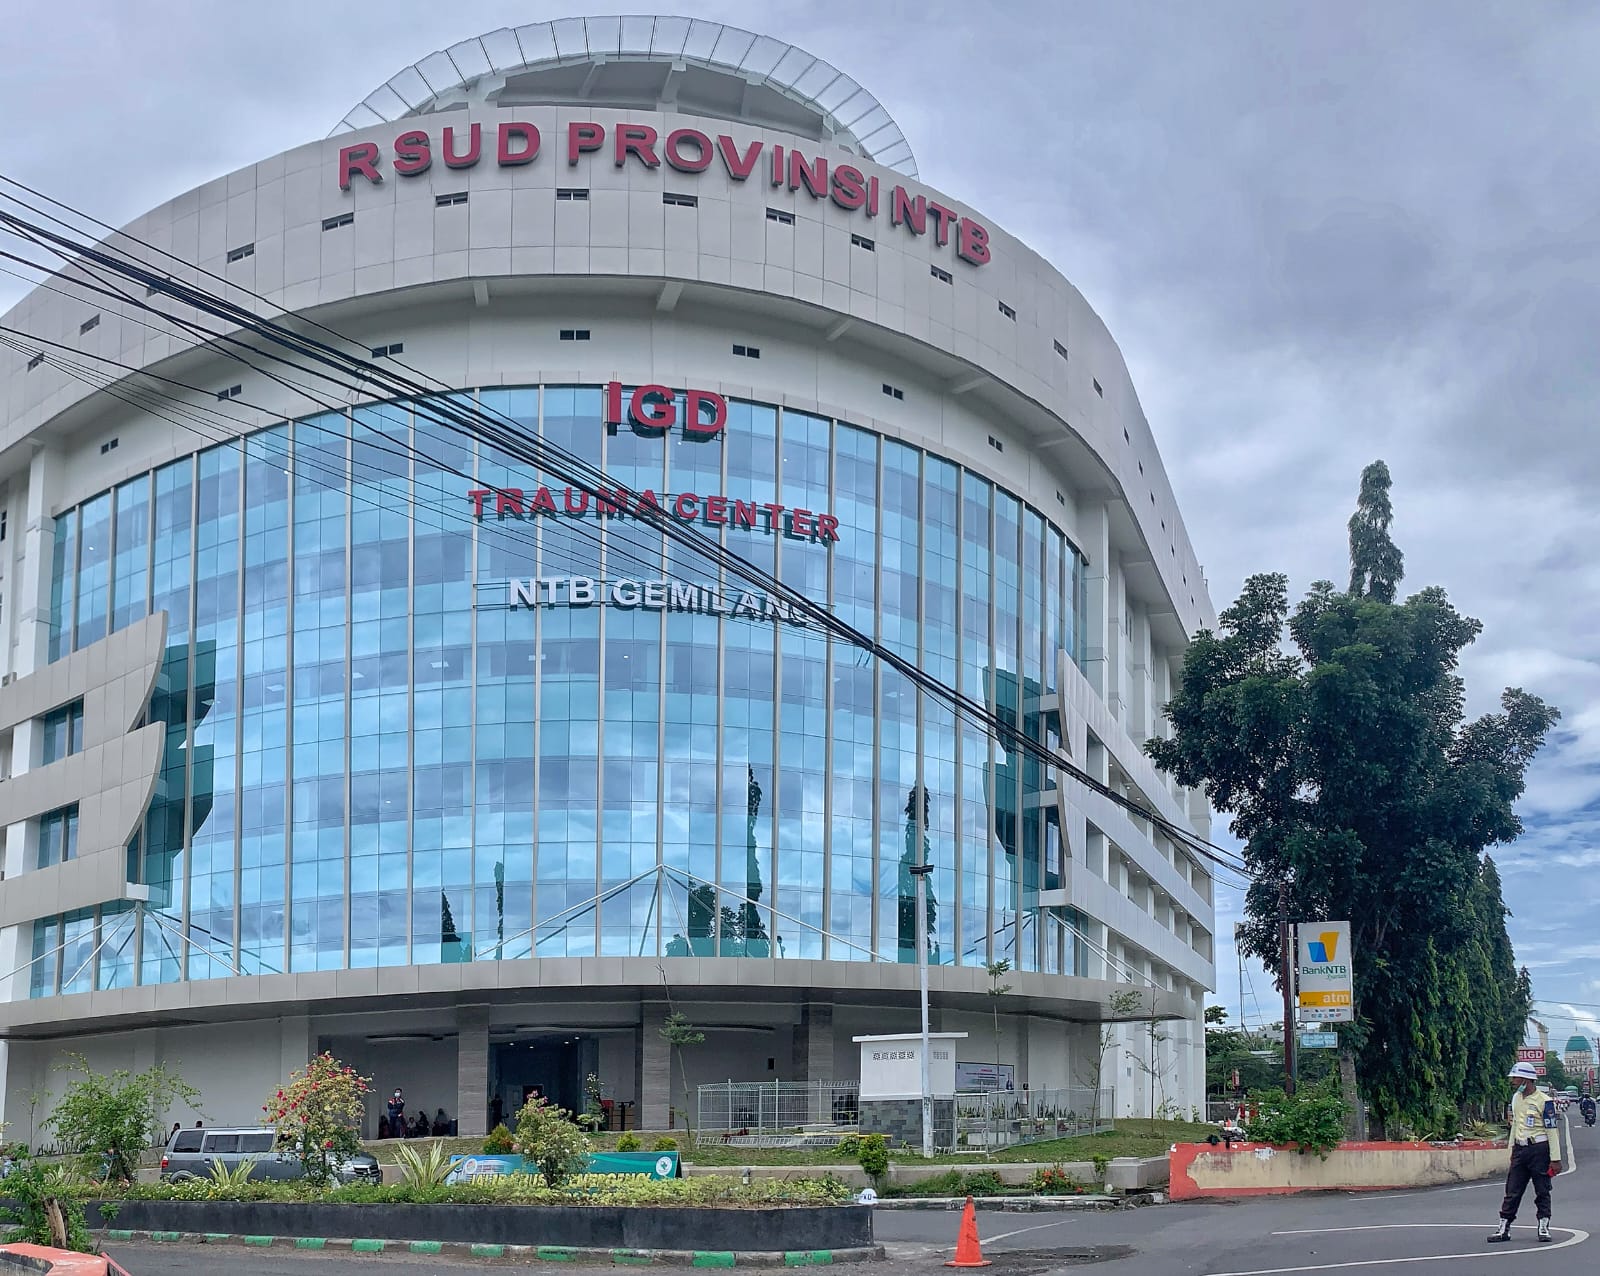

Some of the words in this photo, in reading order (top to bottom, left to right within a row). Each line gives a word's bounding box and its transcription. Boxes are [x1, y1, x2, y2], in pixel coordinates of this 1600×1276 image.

[338, 120, 541, 190] RSUD
[568, 121, 879, 217] PROVINSI
[891, 184, 991, 268] NTB
[607, 381, 728, 437] IGD
[675, 492, 840, 542] CENTER
[509, 576, 596, 607] NTB
[1302, 965, 1346, 975] BankNTB
[1323, 992, 1350, 1004] atm
[1523, 1050, 1543, 1059] IGD
